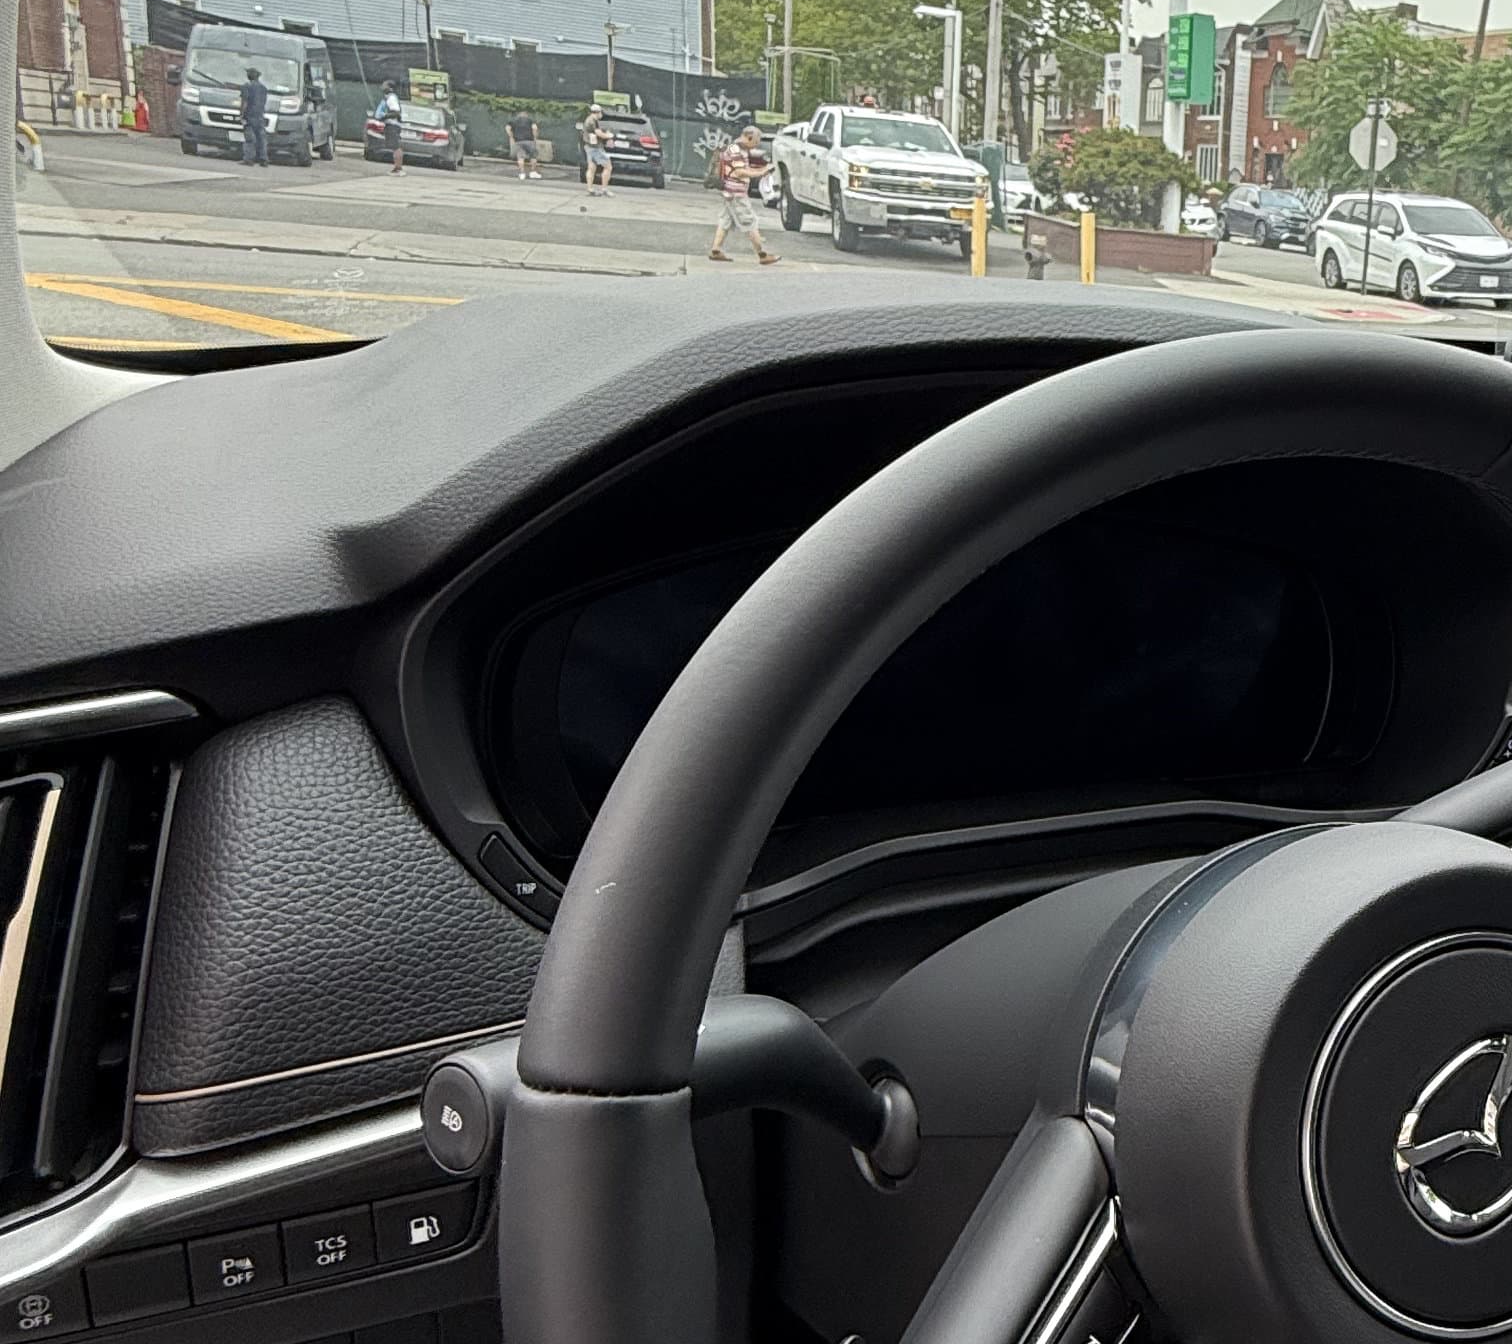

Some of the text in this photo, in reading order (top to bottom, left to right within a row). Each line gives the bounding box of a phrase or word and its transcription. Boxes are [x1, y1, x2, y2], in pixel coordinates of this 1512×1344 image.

[515, 882, 537, 896] TRIP
[314, 1235, 347, 1251] TCS
[316, 1249, 347, 1265] OFF
[223, 1271, 254, 1287] OFF
[19, 1313, 53, 1329] OFF
